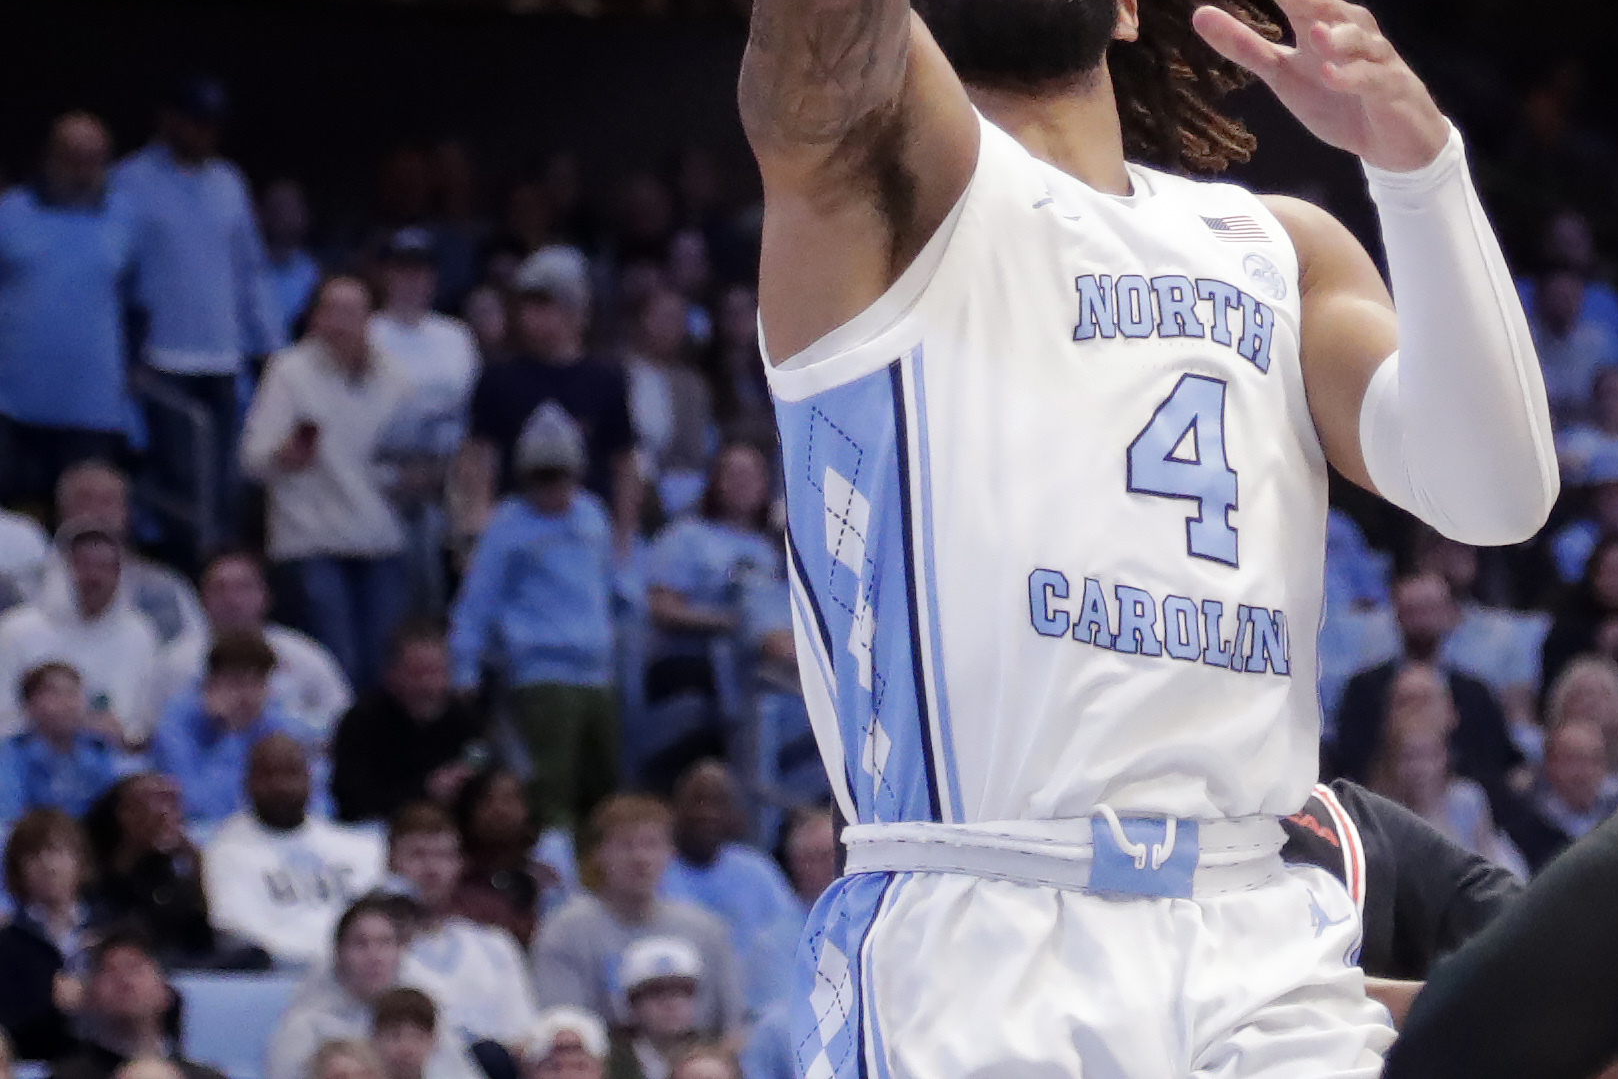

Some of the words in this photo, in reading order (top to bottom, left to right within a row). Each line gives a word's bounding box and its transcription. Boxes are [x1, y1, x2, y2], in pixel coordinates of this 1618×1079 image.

[1073, 274, 1275, 374] NORTH
[1126, 372, 1239, 569] 4
[1028, 568, 1292, 676] CAROLIN
